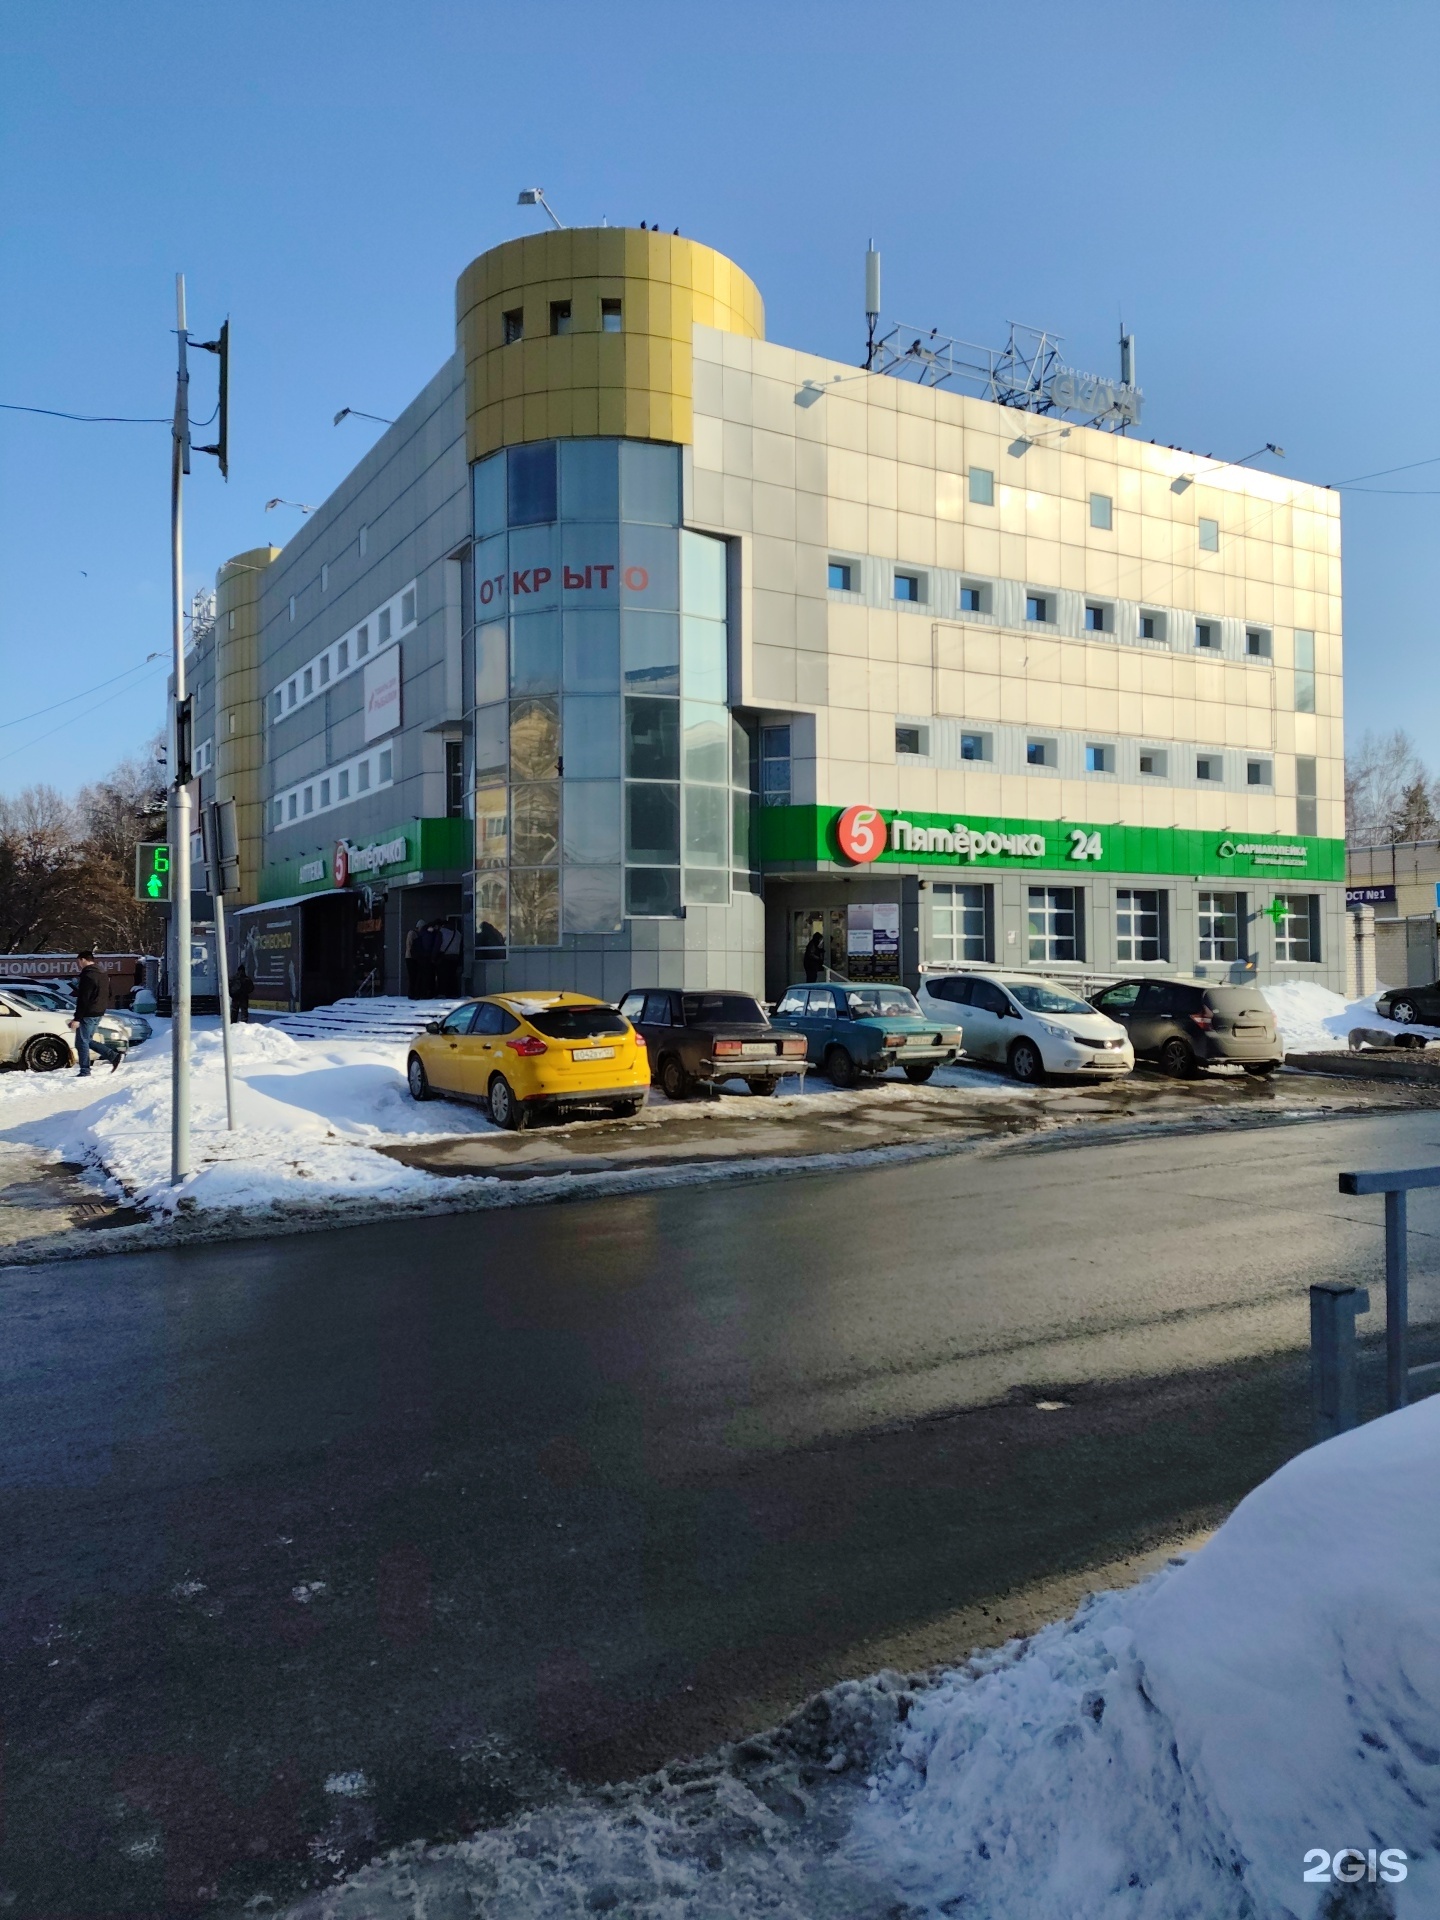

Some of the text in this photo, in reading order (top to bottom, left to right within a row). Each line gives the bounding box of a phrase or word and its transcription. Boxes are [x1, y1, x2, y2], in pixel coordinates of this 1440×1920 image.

[1053, 362, 1115, 387] ТОРГОВЫЙ
[479, 564, 649, 604] ОТКРЫТО
[850, 811, 1104, 861] 5 Пятёрочка 24
[155, 848, 168, 872] 6
[1236, 843, 1307, 856] ФАРМАКОПЕЙКА
[1366, 889, 1386, 899] №1
[0, 961, 82, 974] НОМОНТА
